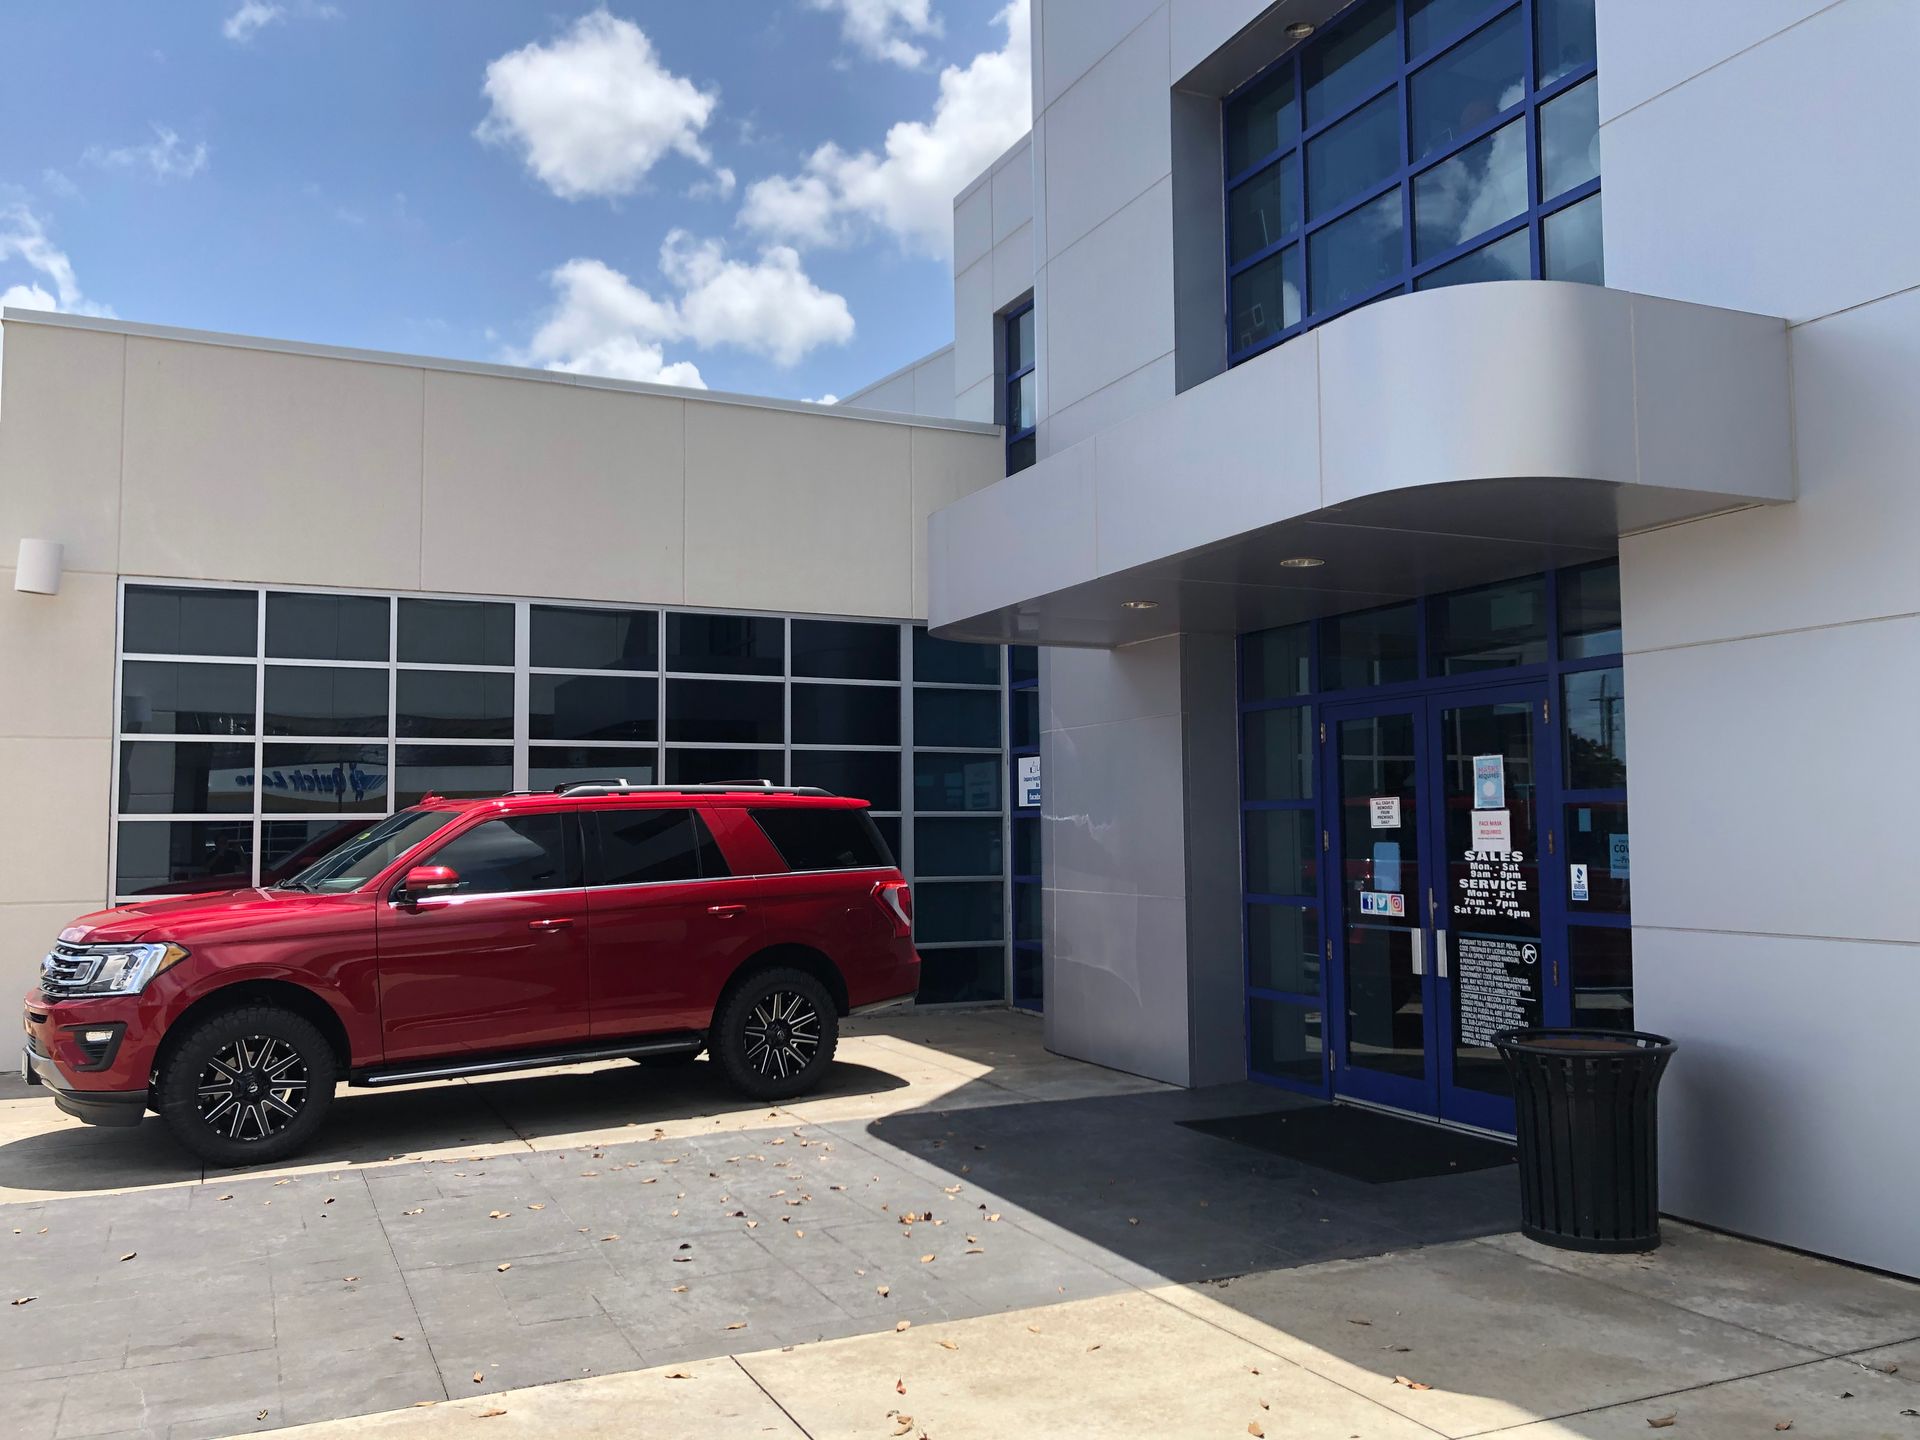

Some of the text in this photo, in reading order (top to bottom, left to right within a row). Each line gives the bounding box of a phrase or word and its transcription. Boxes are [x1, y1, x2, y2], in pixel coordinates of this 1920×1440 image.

[1464, 850, 1523, 862] SALES
[1470, 862, 1492, 870] Mon.
[1502, 863, 1519, 871] Sat
[1500, 871, 1521, 880] 9pm
[1460, 879, 1527, 890] SERVICE
[1496, 899, 1518, 908] 7pm
[1454, 905, 1471, 914] Sat
[1474, 907, 1496, 916] 7am
[1507, 909, 1530, 918] 4pm
